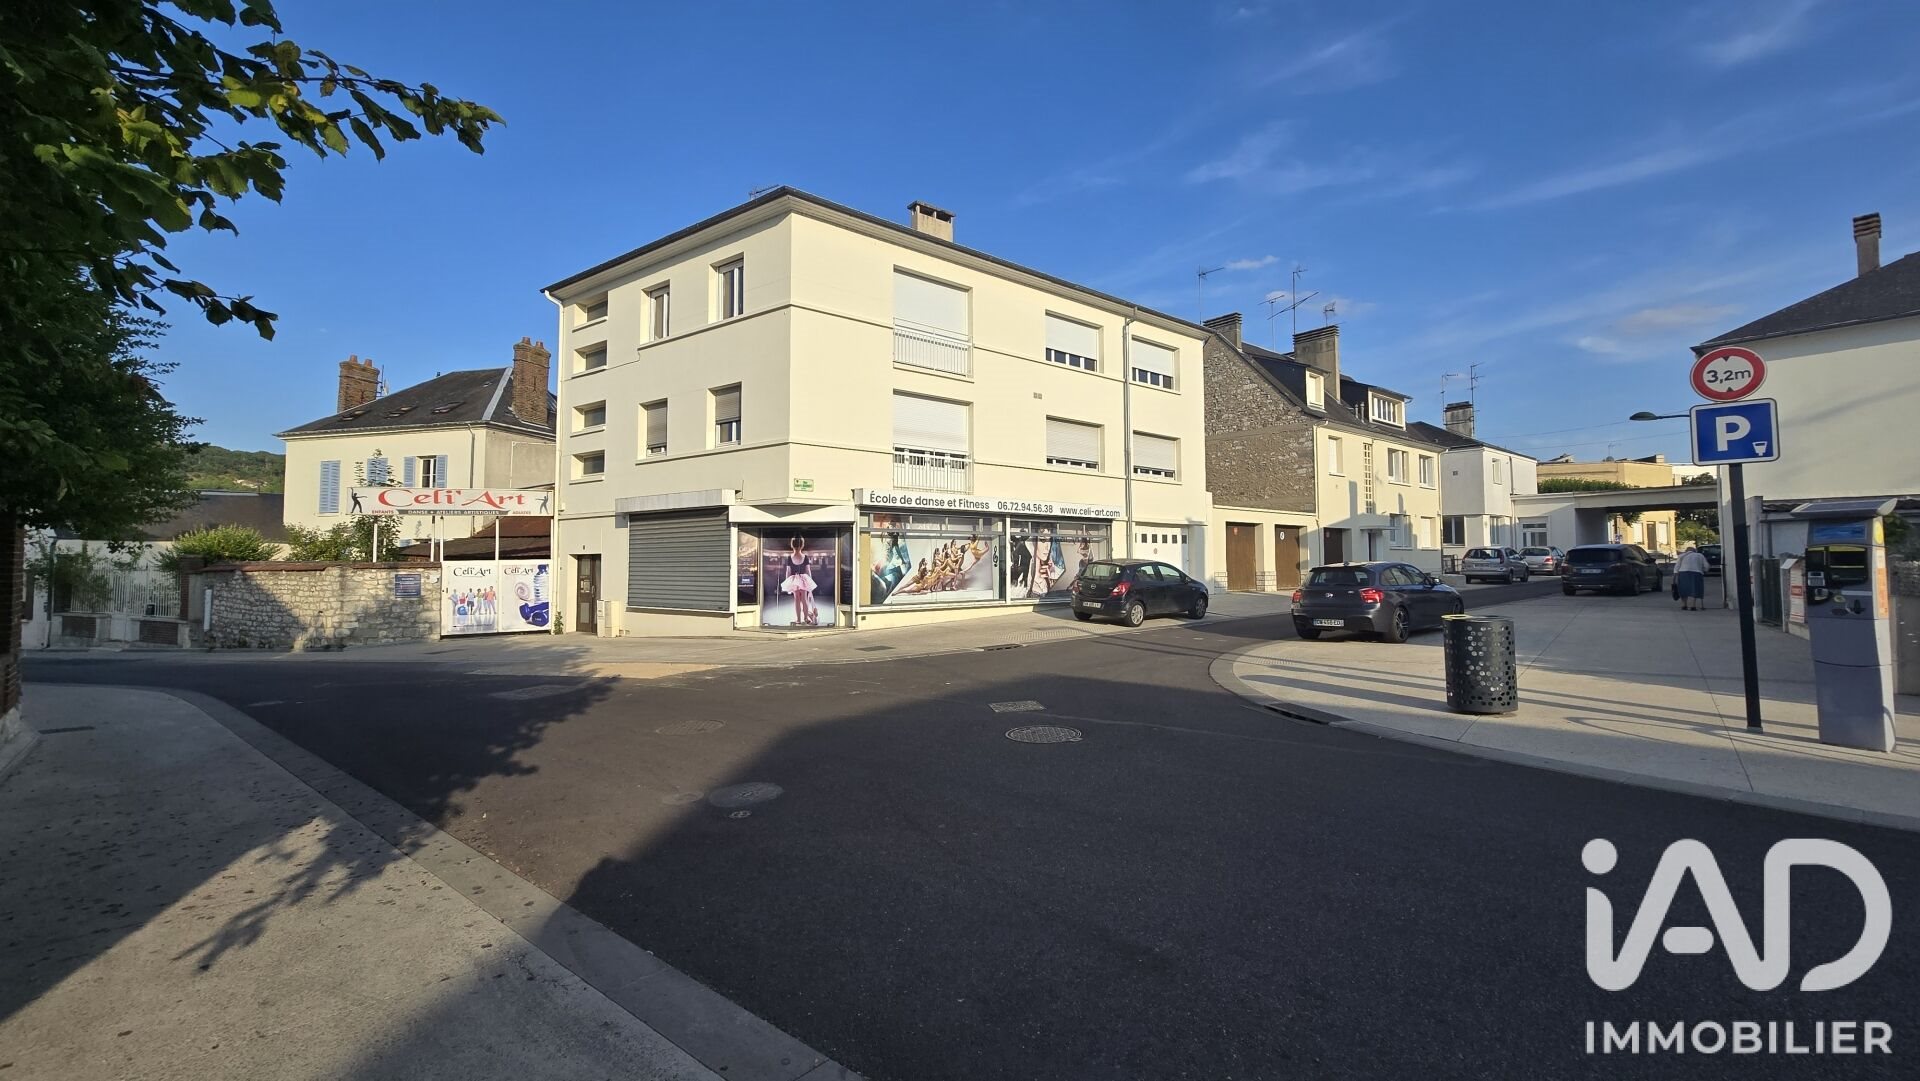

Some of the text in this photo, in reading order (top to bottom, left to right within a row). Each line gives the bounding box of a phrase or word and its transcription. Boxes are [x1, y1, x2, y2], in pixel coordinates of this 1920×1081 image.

[1706, 369, 1751, 384] 3,2m
[1715, 415, 1751, 452] P
[869, 490, 1121, 518] École de danse et Fitness 06.72.94.56.38 www.celi-art.com
